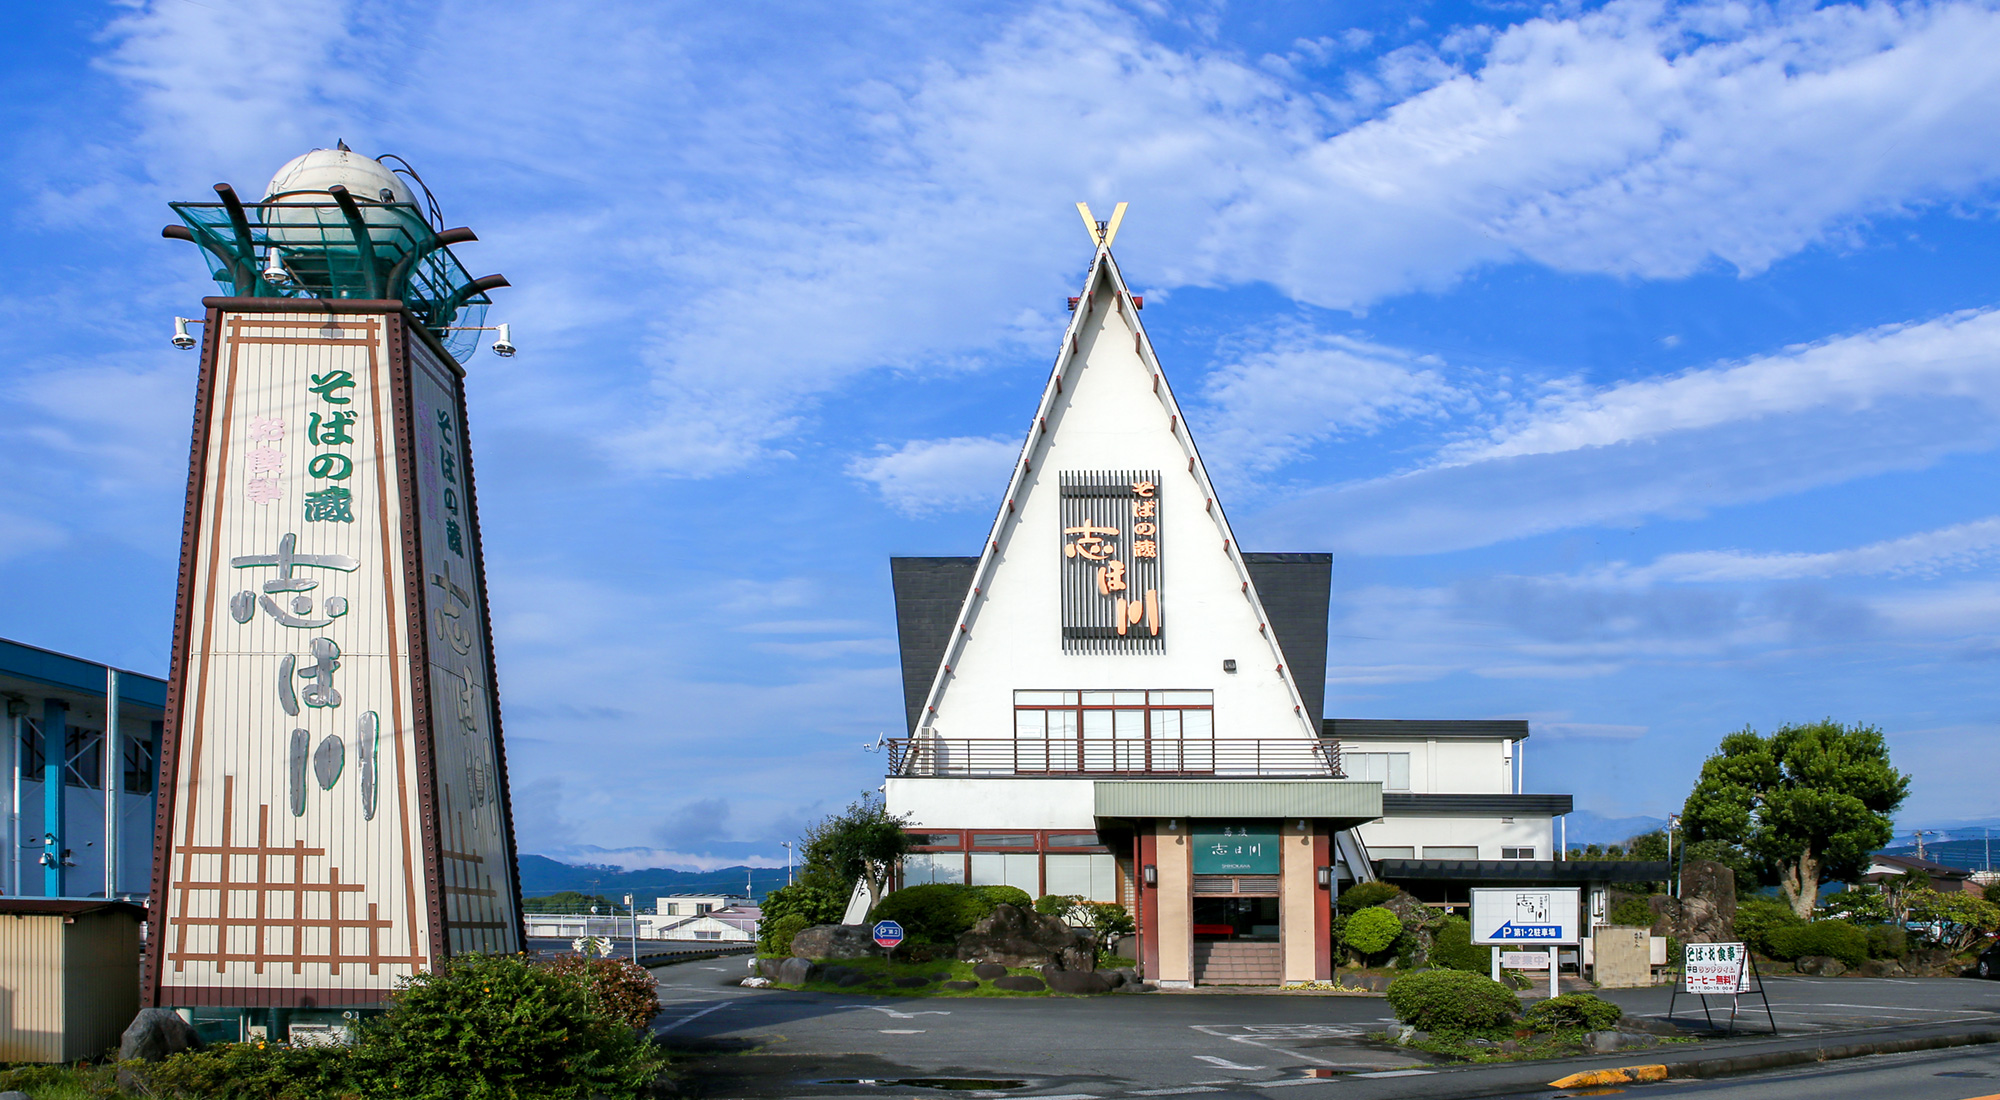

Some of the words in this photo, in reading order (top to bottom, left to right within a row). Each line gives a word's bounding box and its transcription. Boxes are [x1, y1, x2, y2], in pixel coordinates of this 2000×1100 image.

[304, 370, 358, 523] そばの蔵
[1502, 927, 1512, 938] P
